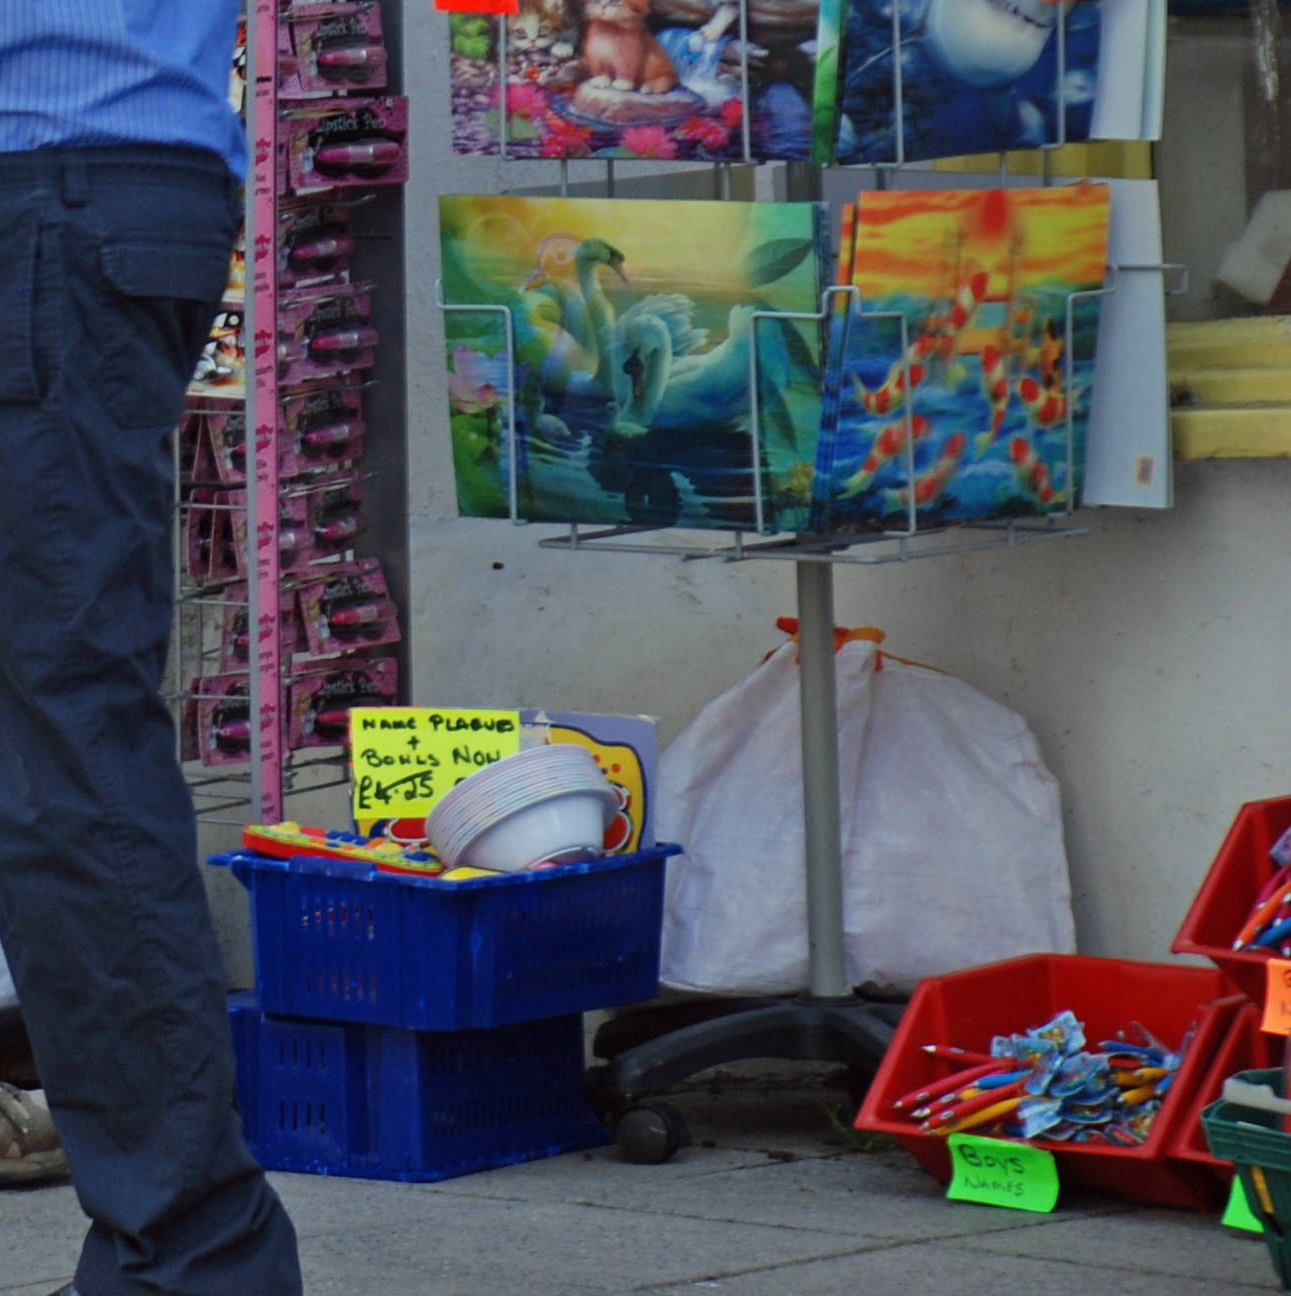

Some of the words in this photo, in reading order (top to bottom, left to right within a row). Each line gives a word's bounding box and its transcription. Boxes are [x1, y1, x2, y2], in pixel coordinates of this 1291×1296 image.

[362, 716, 417, 731] NAME
[360, 748, 440, 768] BOWLS
[452, 745, 501, 766] NOW
